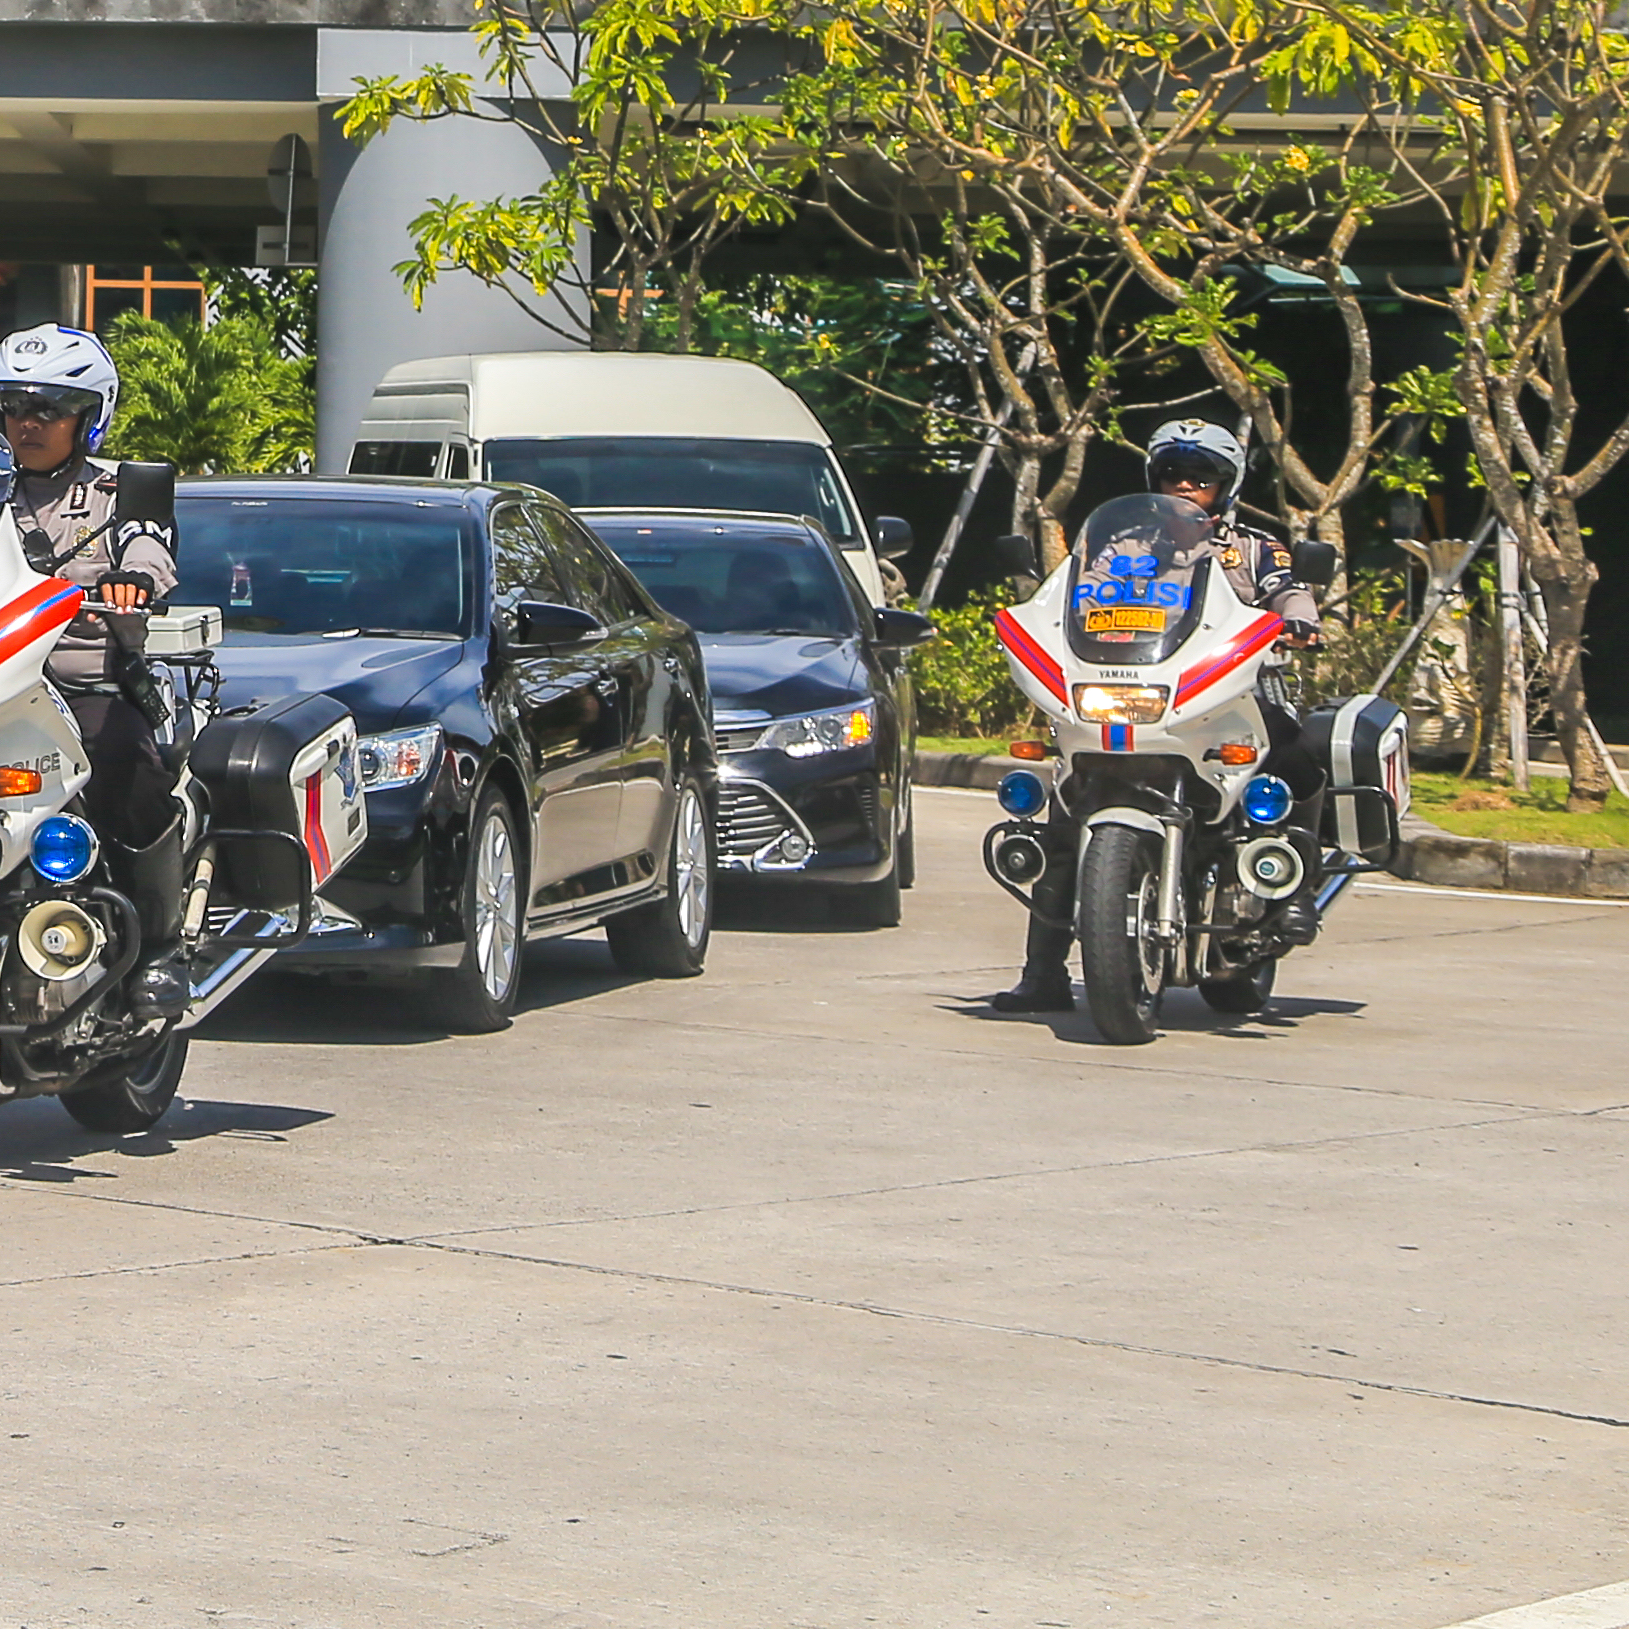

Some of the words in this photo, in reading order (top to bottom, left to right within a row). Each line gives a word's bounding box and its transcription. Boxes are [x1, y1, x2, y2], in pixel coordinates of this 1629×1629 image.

[1072, 580, 1194, 610] POLISI
[1099, 670, 1140, 680] YAMAHA
[0, 752, 61, 774] ICE
